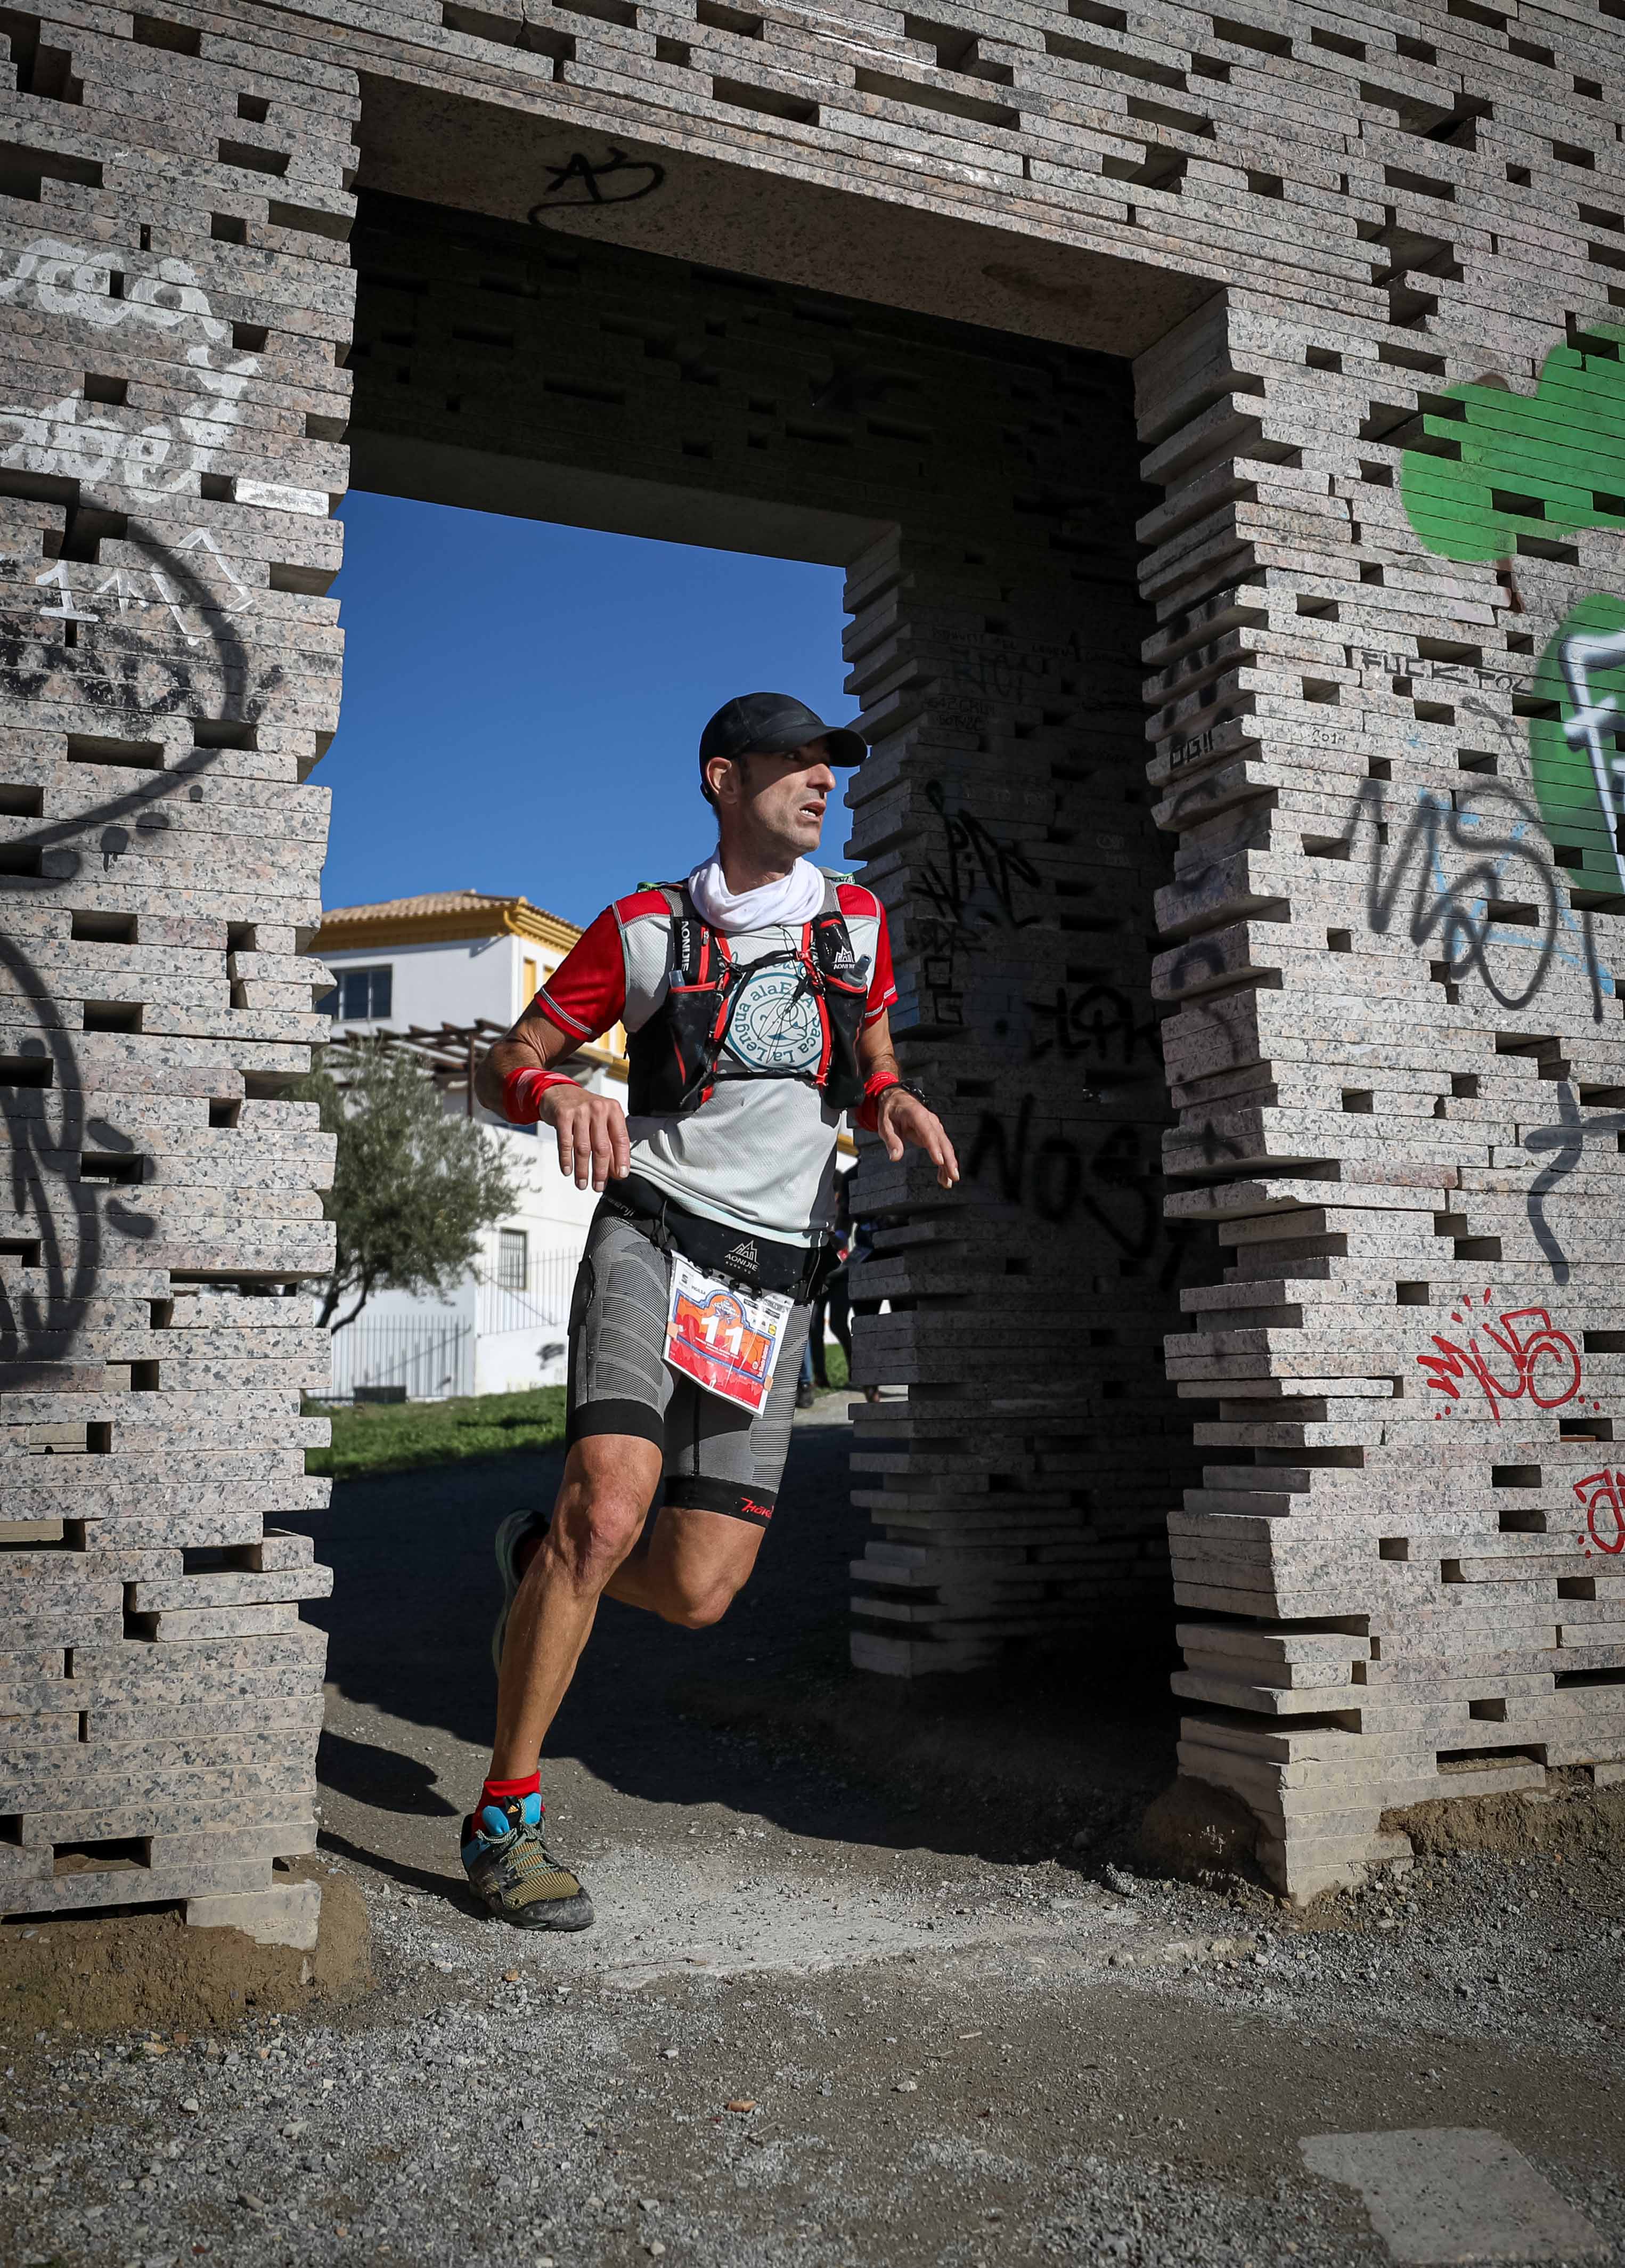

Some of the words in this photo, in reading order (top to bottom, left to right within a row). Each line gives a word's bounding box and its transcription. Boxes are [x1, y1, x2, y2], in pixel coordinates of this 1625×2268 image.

[1361, 651, 1468, 684] FUCK
[1312, 729, 1346, 745] 2014
[681, 921, 690, 972] AONIJIE
[734, 1002, 768, 1062] Lengua
[773, 1050, 795, 1063] La
[724, 1253, 758, 1272] AONIJIE
[700, 1315, 745, 1356] 11
